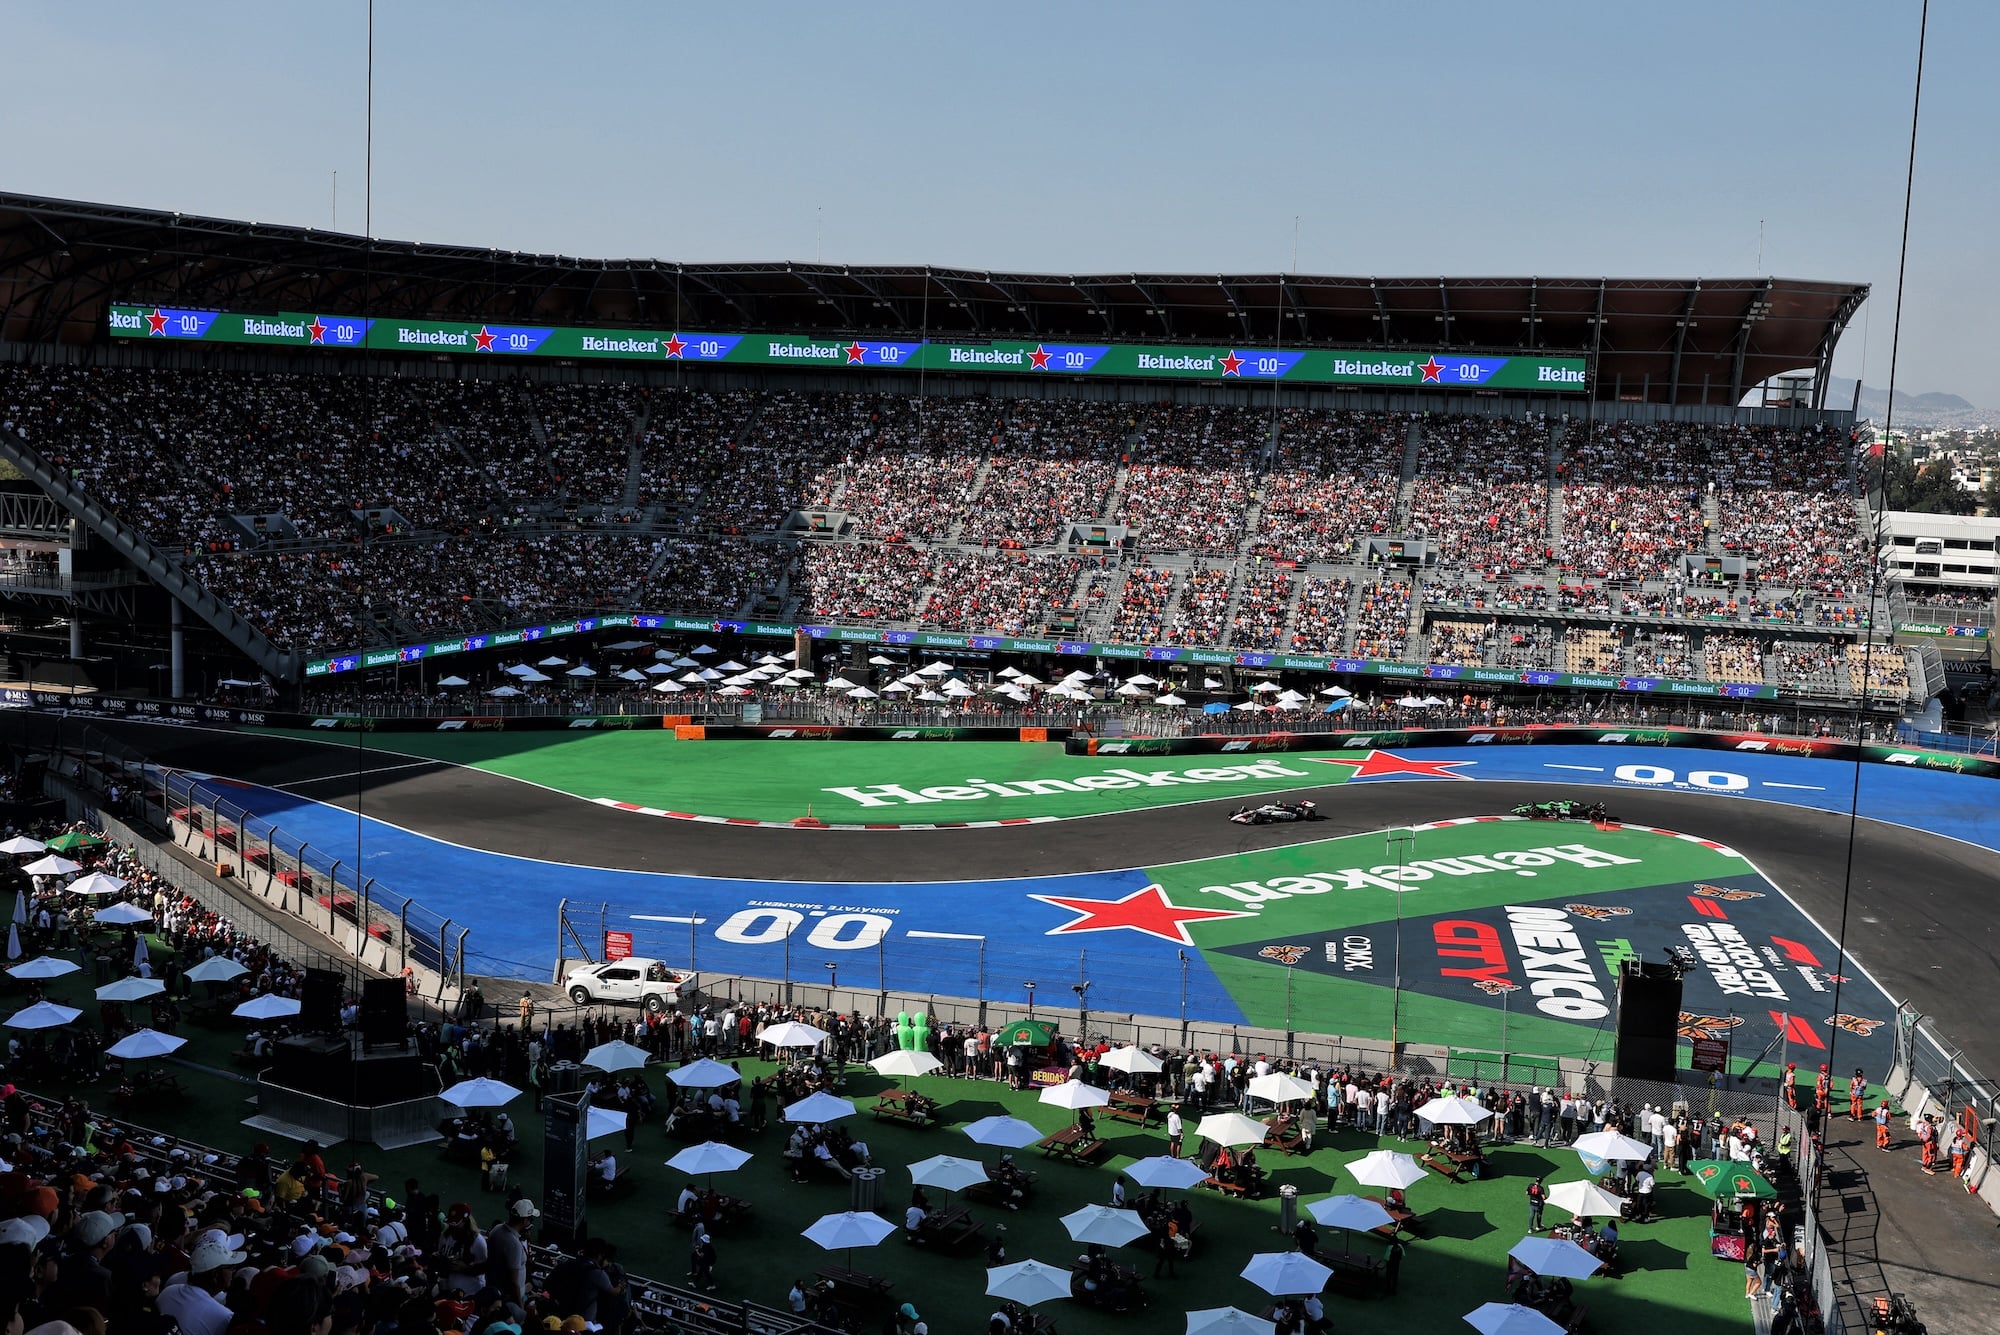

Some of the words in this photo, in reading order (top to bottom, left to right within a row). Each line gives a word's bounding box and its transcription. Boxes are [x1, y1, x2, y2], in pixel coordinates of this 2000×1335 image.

[243, 319, 304, 337] Heineken
[398, 328, 467, 345] Heineken
[582, 336, 657, 353] Heineken
[768, 343, 839, 358] Heineken
[949, 348, 1022, 364] Heineken
[1138, 354, 1213, 370] Heineken
[1333, 360, 1412, 376] Heineken
[1537, 366, 1585, 382] Heine
[1901, 623, 1941, 634] Heineken
[926, 636, 963, 646] Heineken
[1013, 641, 1050, 651] Heineken
[1102, 647, 1139, 657] Heineken
[1192, 653, 1230, 663] Heineken
[1285, 659, 1323, 668] Heineken
[1379, 665, 1418, 675] Heineken
[1474, 671, 1514, 681] Heineken
[1572, 677, 1613, 687] Heineken
[1672, 683, 1713, 693] Heineken
[44, 694, 60, 703] MSC
[77, 697, 93, 705] MSC
[109, 700, 126, 708] MSC
[143, 703, 159, 711] MSC
[179, 706, 195, 715] MSC
[213, 709, 230, 718] MSC
[248, 712, 265, 722] MSC
[1615, 765, 1749, 790] 0.0
[822, 760, 1308, 807] Heineken
[1200, 844, 1642, 905] Heineken
[747, 900, 823, 910] SANAMENTE
[714, 908, 893, 950] 0.0
[1432, 919, 1514, 985] CITY
[1503, 905, 1610, 1020] MEXICO
[1681, 923, 1731, 963] GRAND
[1706, 963, 1755, 997] PRIX
[1706, 922, 1764, 968] MEXICO
[1741, 968, 1790, 1001] CITY
[1032, 1070, 1065, 1084] BEBIDAS
